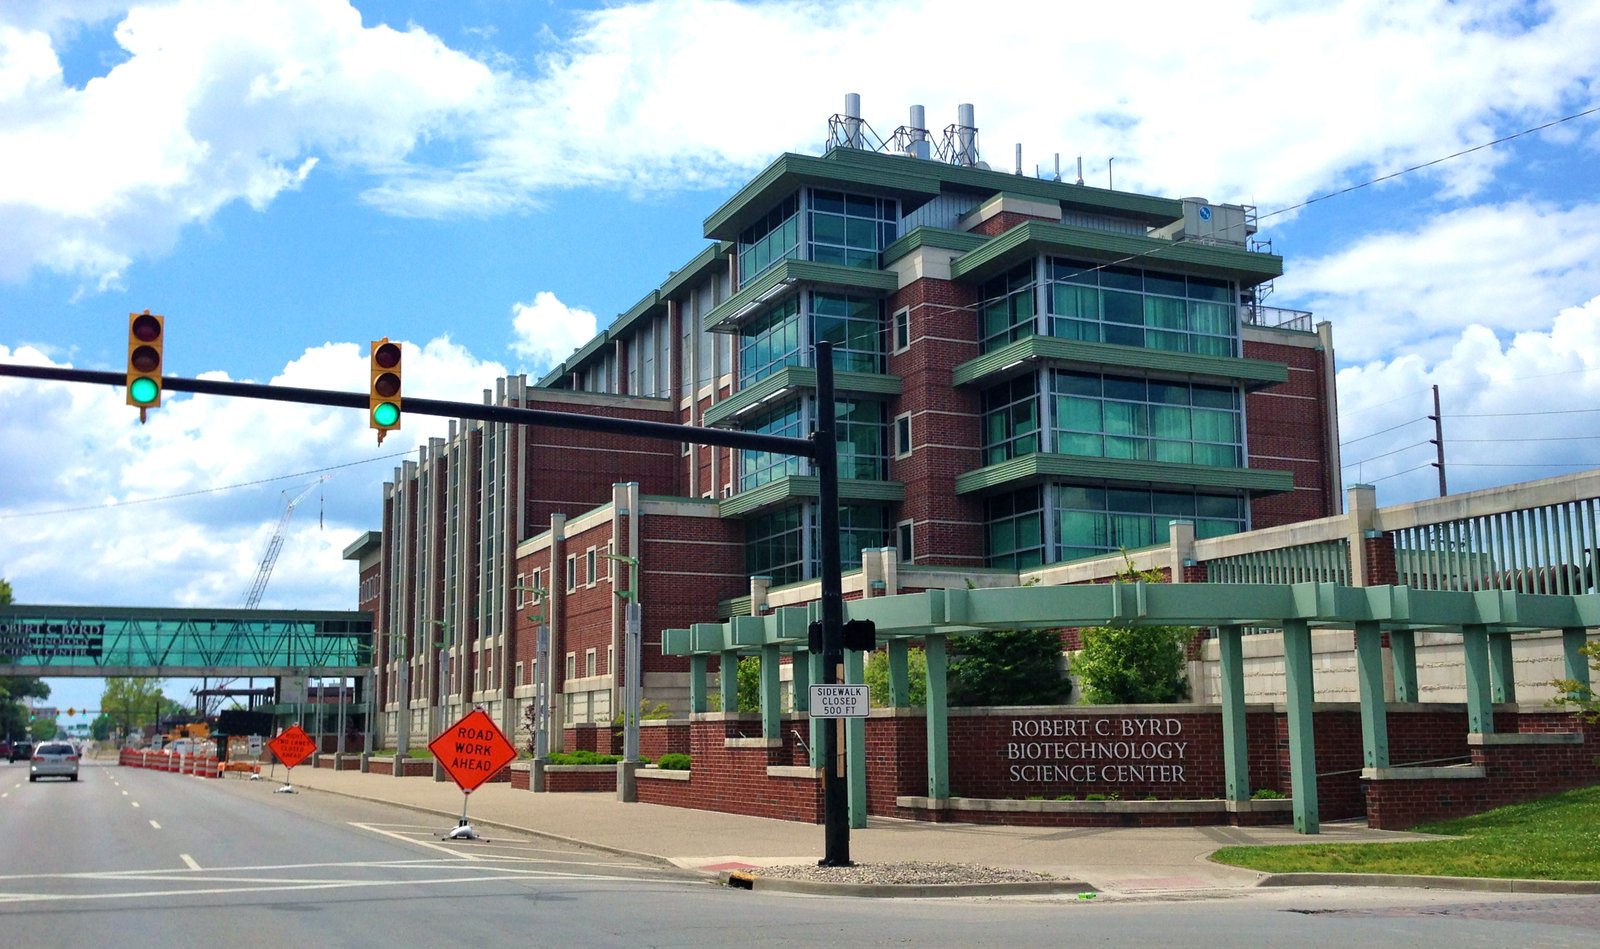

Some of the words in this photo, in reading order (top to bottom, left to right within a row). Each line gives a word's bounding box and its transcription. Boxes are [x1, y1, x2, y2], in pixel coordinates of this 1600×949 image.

[0, 624, 41, 634] OBERT
[62, 624, 100, 634] BYRD
[45, 648, 87, 657] CENTER
[817, 687, 862, 696] SIDEWALK
[822, 697, 857, 705] CLOSED
[824, 706, 842, 714] 500
[845, 706, 856, 714] FT
[458, 727, 494, 741] ROAD
[1011, 719, 1090, 737] ROBERT
[1095, 719, 1115, 736] C.
[1121, 718, 1182, 736] BYRD
[455, 742, 492, 756] WORK
[1007, 742, 1188, 760] BIOTECHNOLOGY
[451, 757, 492, 771] AHEAD
[1009, 765, 1096, 782] SCIENCE
[1101, 765, 1186, 782] CENTER
